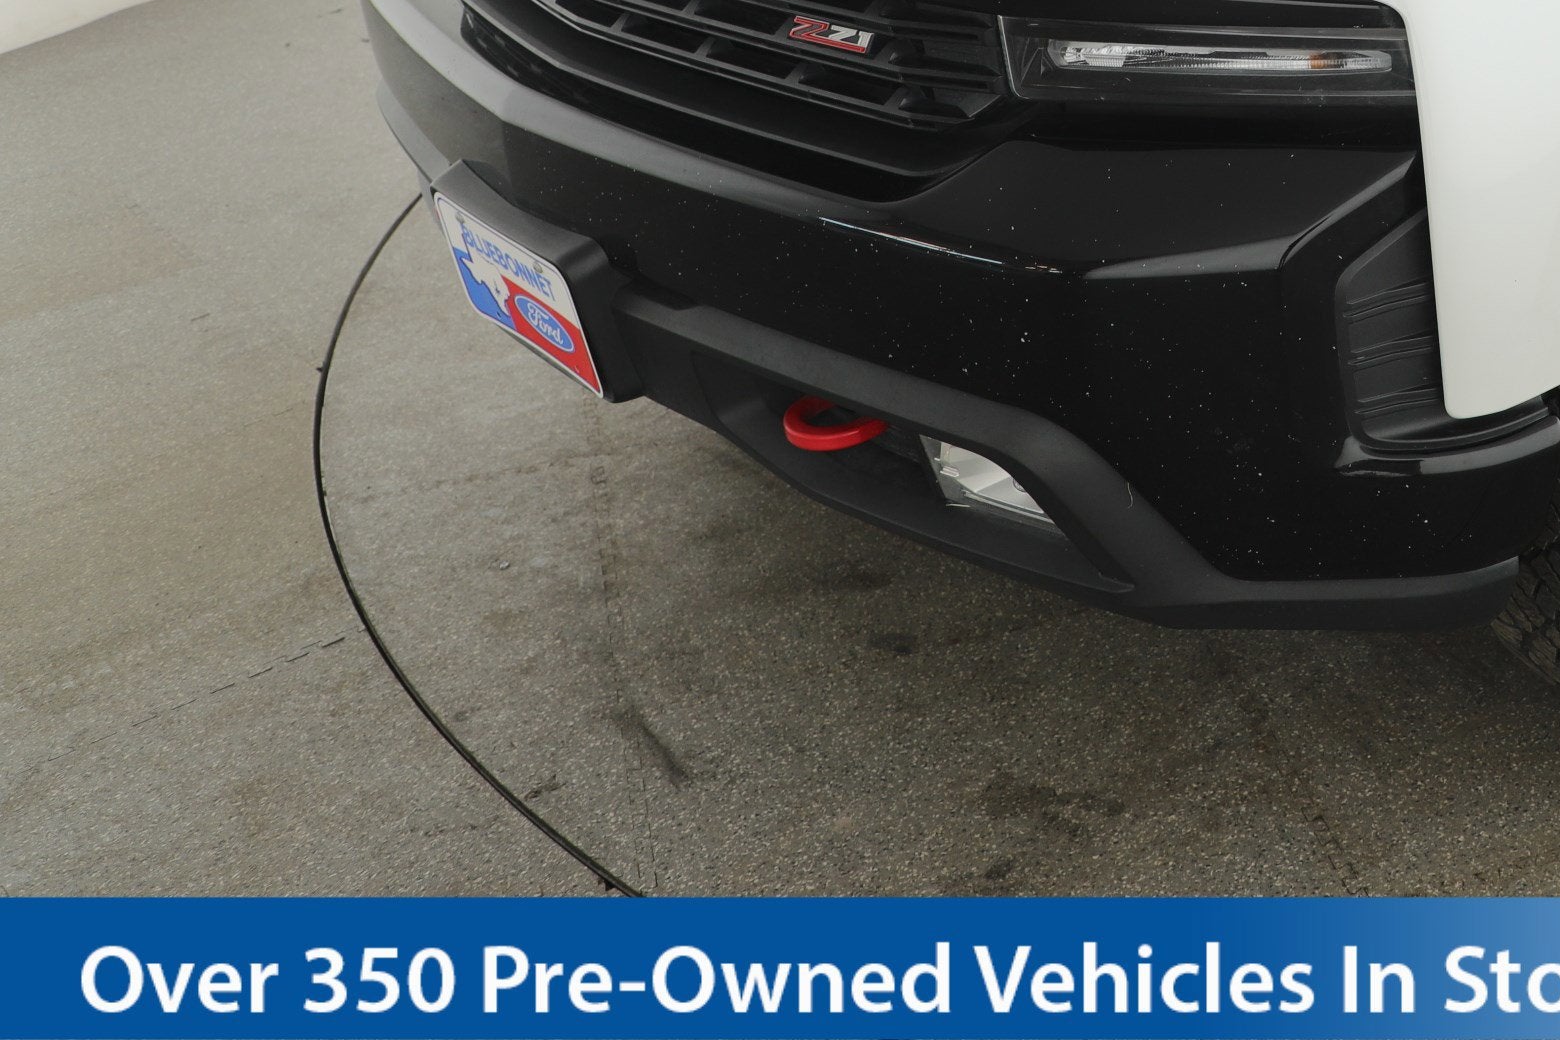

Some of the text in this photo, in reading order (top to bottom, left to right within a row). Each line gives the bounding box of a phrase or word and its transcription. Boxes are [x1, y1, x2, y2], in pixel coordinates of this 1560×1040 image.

[789, 15, 876, 54] Z71
[461, 221, 557, 303] BLUEBONNET
[527, 301, 564, 345] Ford
